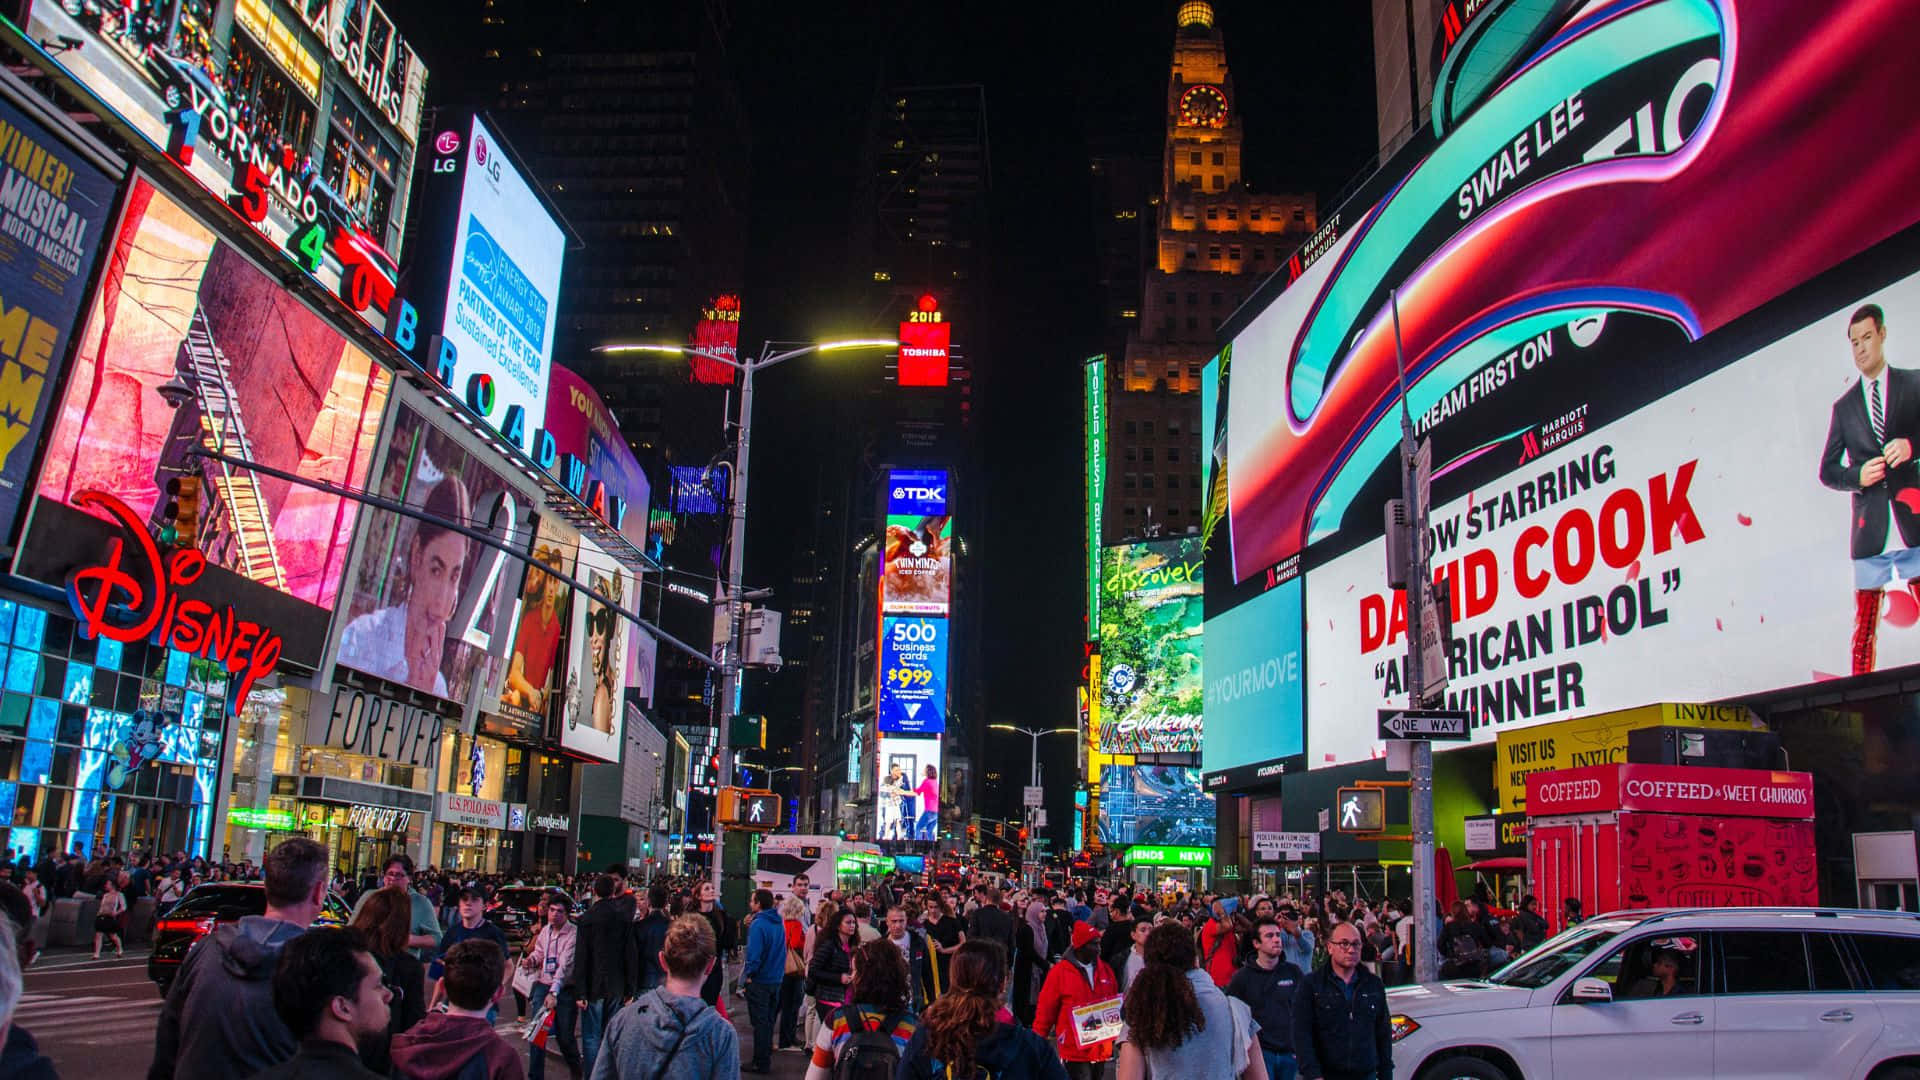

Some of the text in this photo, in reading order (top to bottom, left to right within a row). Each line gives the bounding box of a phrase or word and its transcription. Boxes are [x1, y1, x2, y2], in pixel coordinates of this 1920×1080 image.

[190, 80, 318, 223] VORNADO
[433, 158, 456, 173] LG
[487, 152, 501, 183] LG
[1458, 90, 1584, 221] SWAE LEE
[0, 168, 87, 257] MUSICAL
[2, 212, 38, 249] NORTH
[36, 235, 82, 276] AMERICA
[1304, 214, 1341, 257] MARRIOTT
[1304, 232, 1337, 269] MARQUIS
[499, 255, 546, 321] ENERGY STAR
[459, 278, 496, 332] PARTNER
[496, 318, 507, 341] OF
[508, 328, 522, 357] THE
[522, 342, 541, 377] YEAR
[496, 283, 541, 342] AWARD 2018
[910, 311, 942, 323] 2018
[456, 303, 538, 399] Sustained Excellence
[902, 348, 946, 357] TOSHIBA
[1470, 351, 1519, 404] FIRST
[1521, 331, 1552, 370] ON
[569, 385, 593, 418] YOU
[1542, 404, 1588, 436] MARRIOTT
[1543, 420, 1583, 450] MARQUIS
[905, 487, 942, 500] TDK
[1466, 445, 1616, 540] STARRING
[1360, 459, 1706, 655] DAID COOK
[1107, 549, 1204, 599] discover
[892, 641, 936, 652] business
[893, 623, 936, 642] 500
[899, 652, 928, 661] cards
[1207, 651, 1297, 707] #YOURMOVE
[324, 685, 443, 769] FOREVER
[1392, 718, 1459, 732] ONE WAY
[1509, 738, 1556, 765] VISIT US
[463, 799, 482, 815] POLO
[1539, 779, 1601, 803] COFFEED
[1626, 780, 1714, 800] COFFEED
[1722, 785, 1757, 802] SWEET
[1760, 786, 1807, 805] CHURROS
[348, 804, 411, 833] FOREVER 21
[1179, 851, 1205, 862] NEW
